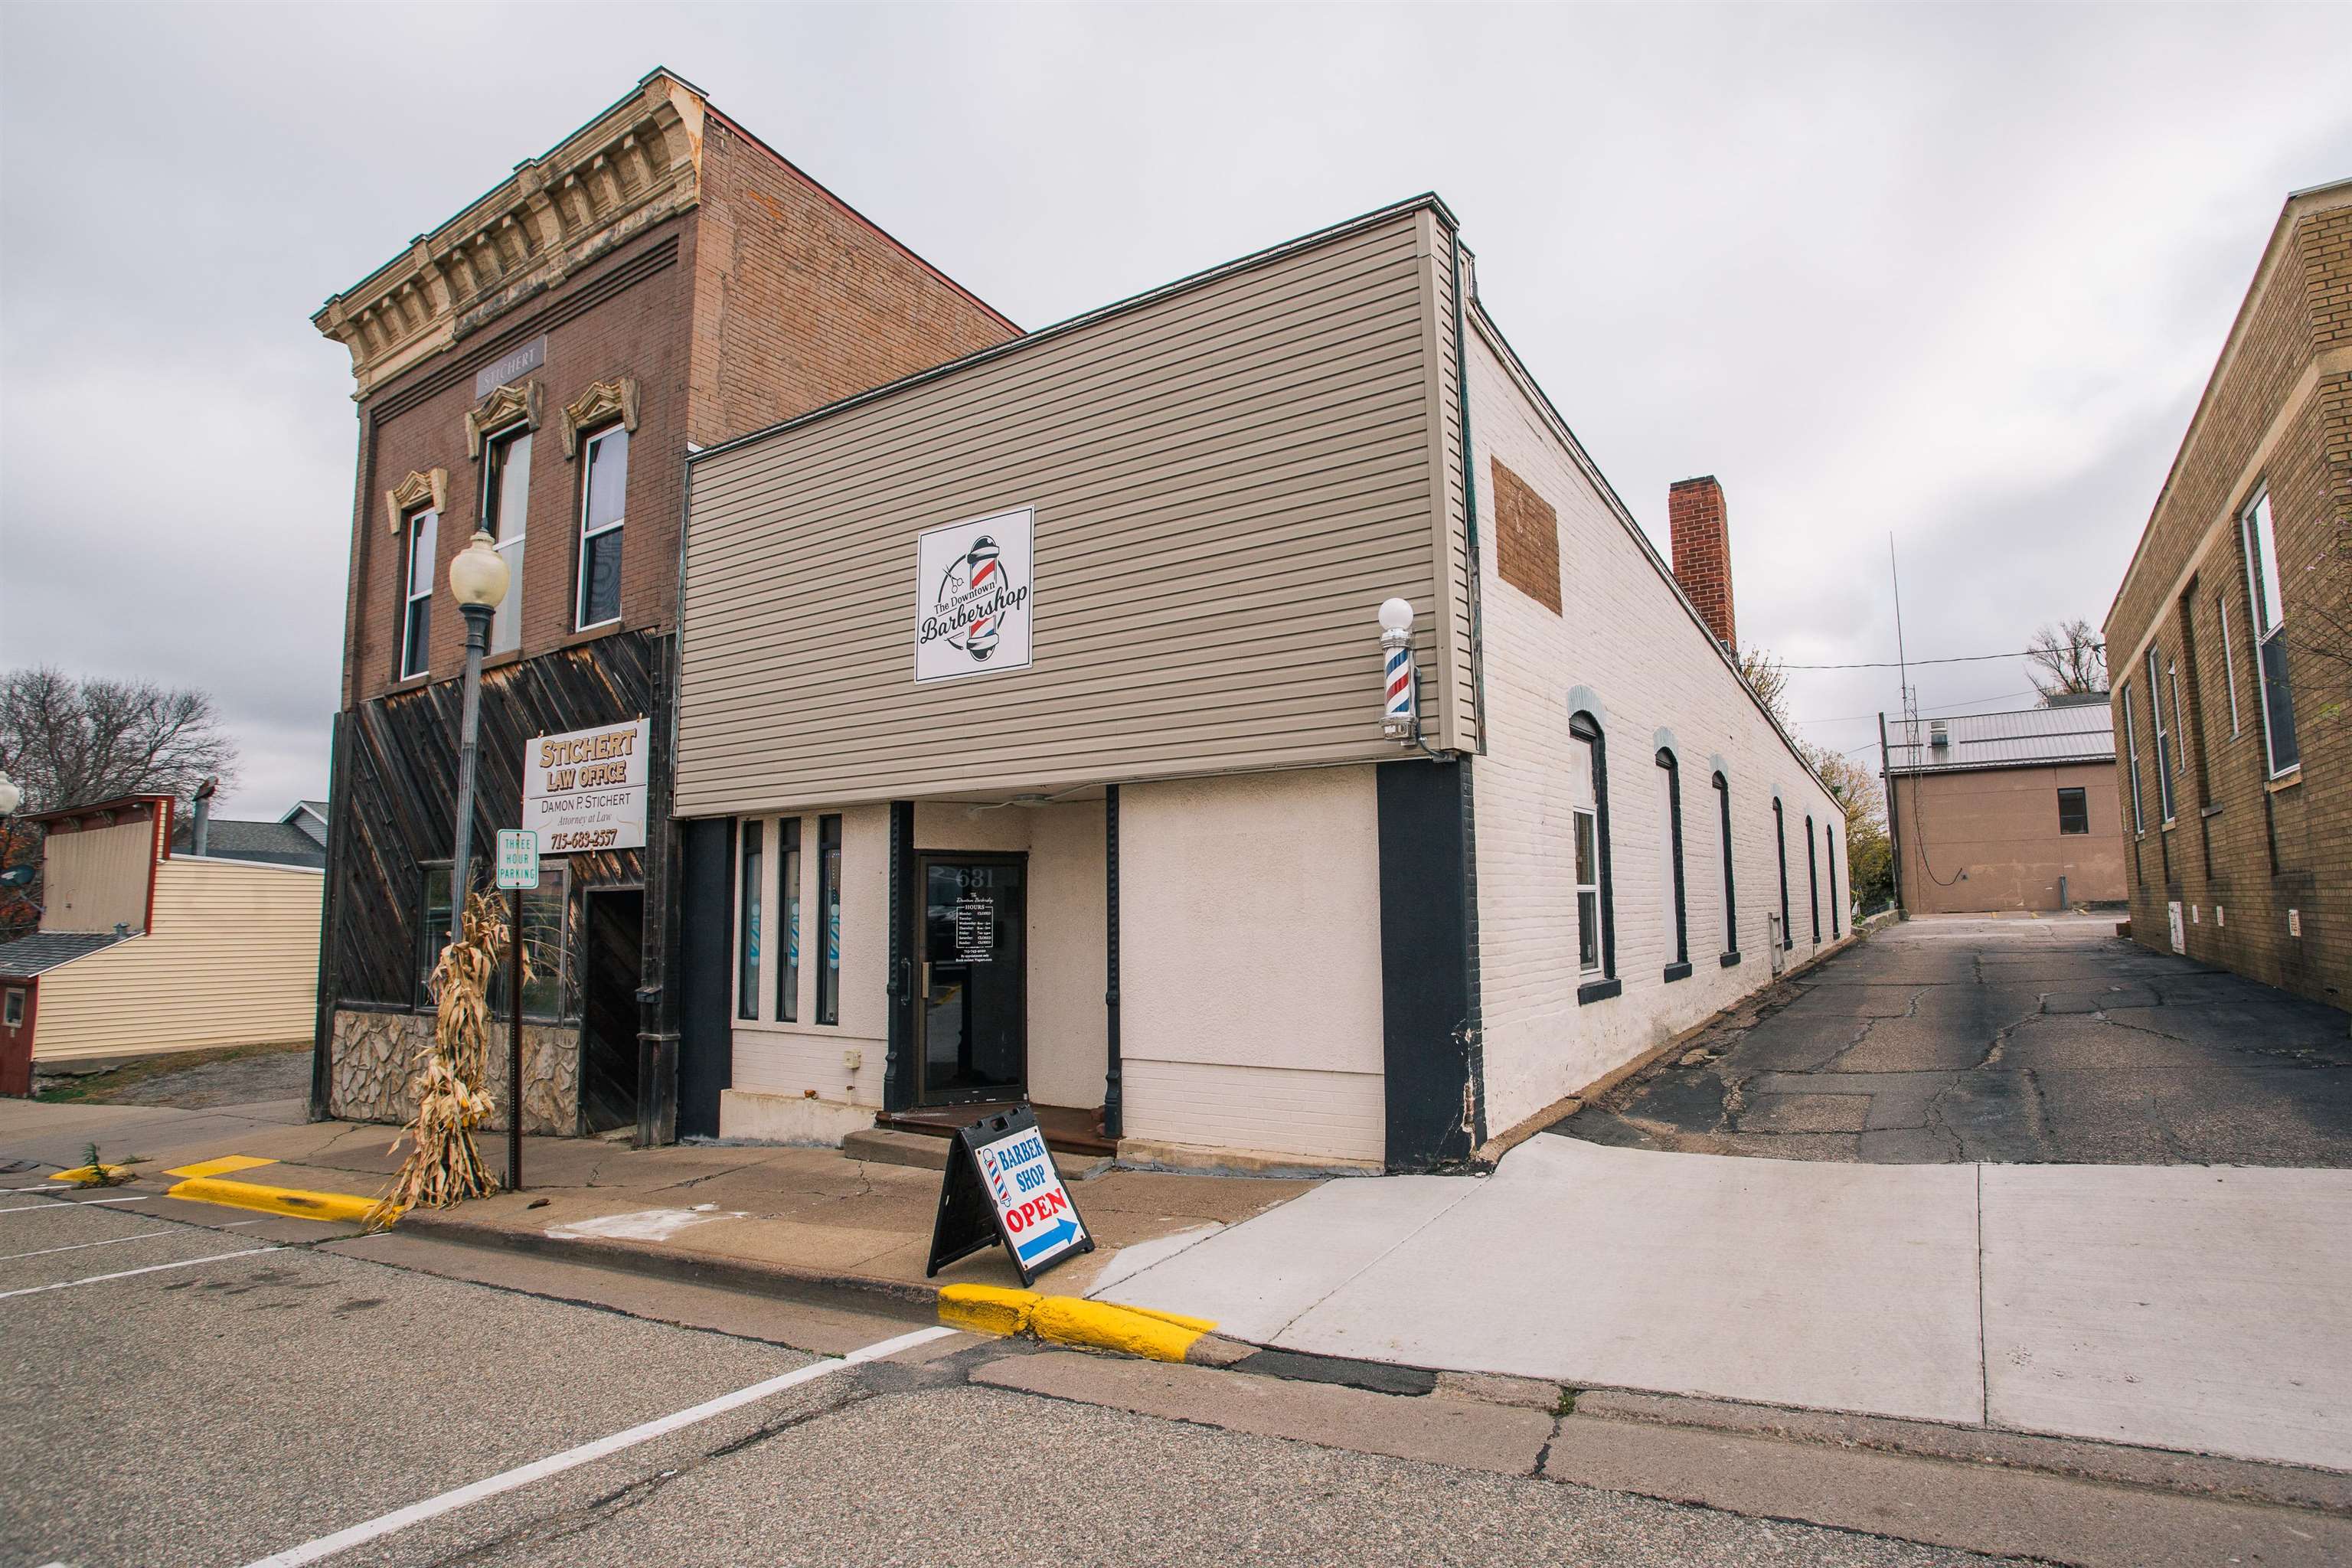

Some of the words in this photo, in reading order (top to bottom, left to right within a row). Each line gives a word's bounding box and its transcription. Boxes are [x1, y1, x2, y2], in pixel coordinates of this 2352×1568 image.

[484, 348, 535, 390] STICHERT
[934, 603, 949, 614] The
[951, 582, 995, 607] Downtown
[920, 586, 1027, 644] Barbershop
[539, 728, 637, 768] STICHERT
[547, 768, 576, 792] LAW
[579, 760, 626, 787] OFFICE
[541, 800, 574, 813] DAMON
[577, 796, 583, 809] P.
[585, 793, 631, 808] STICHERT
[557, 816, 586, 827] Attorney
[588, 815, 596, 823] at
[597, 812, 612, 822] Law
[505, 839, 531, 849] THREE
[551, 828, 618, 850] 715-683-2557
[506, 854, 528, 864] HOUR
[500, 868, 534, 879] PARKING
[956, 869, 994, 887] 631
[998, 1137, 1045, 1171] BARBER
[1016, 1164, 1046, 1192] SHOP
[1006, 1187, 1067, 1233] OPEN
